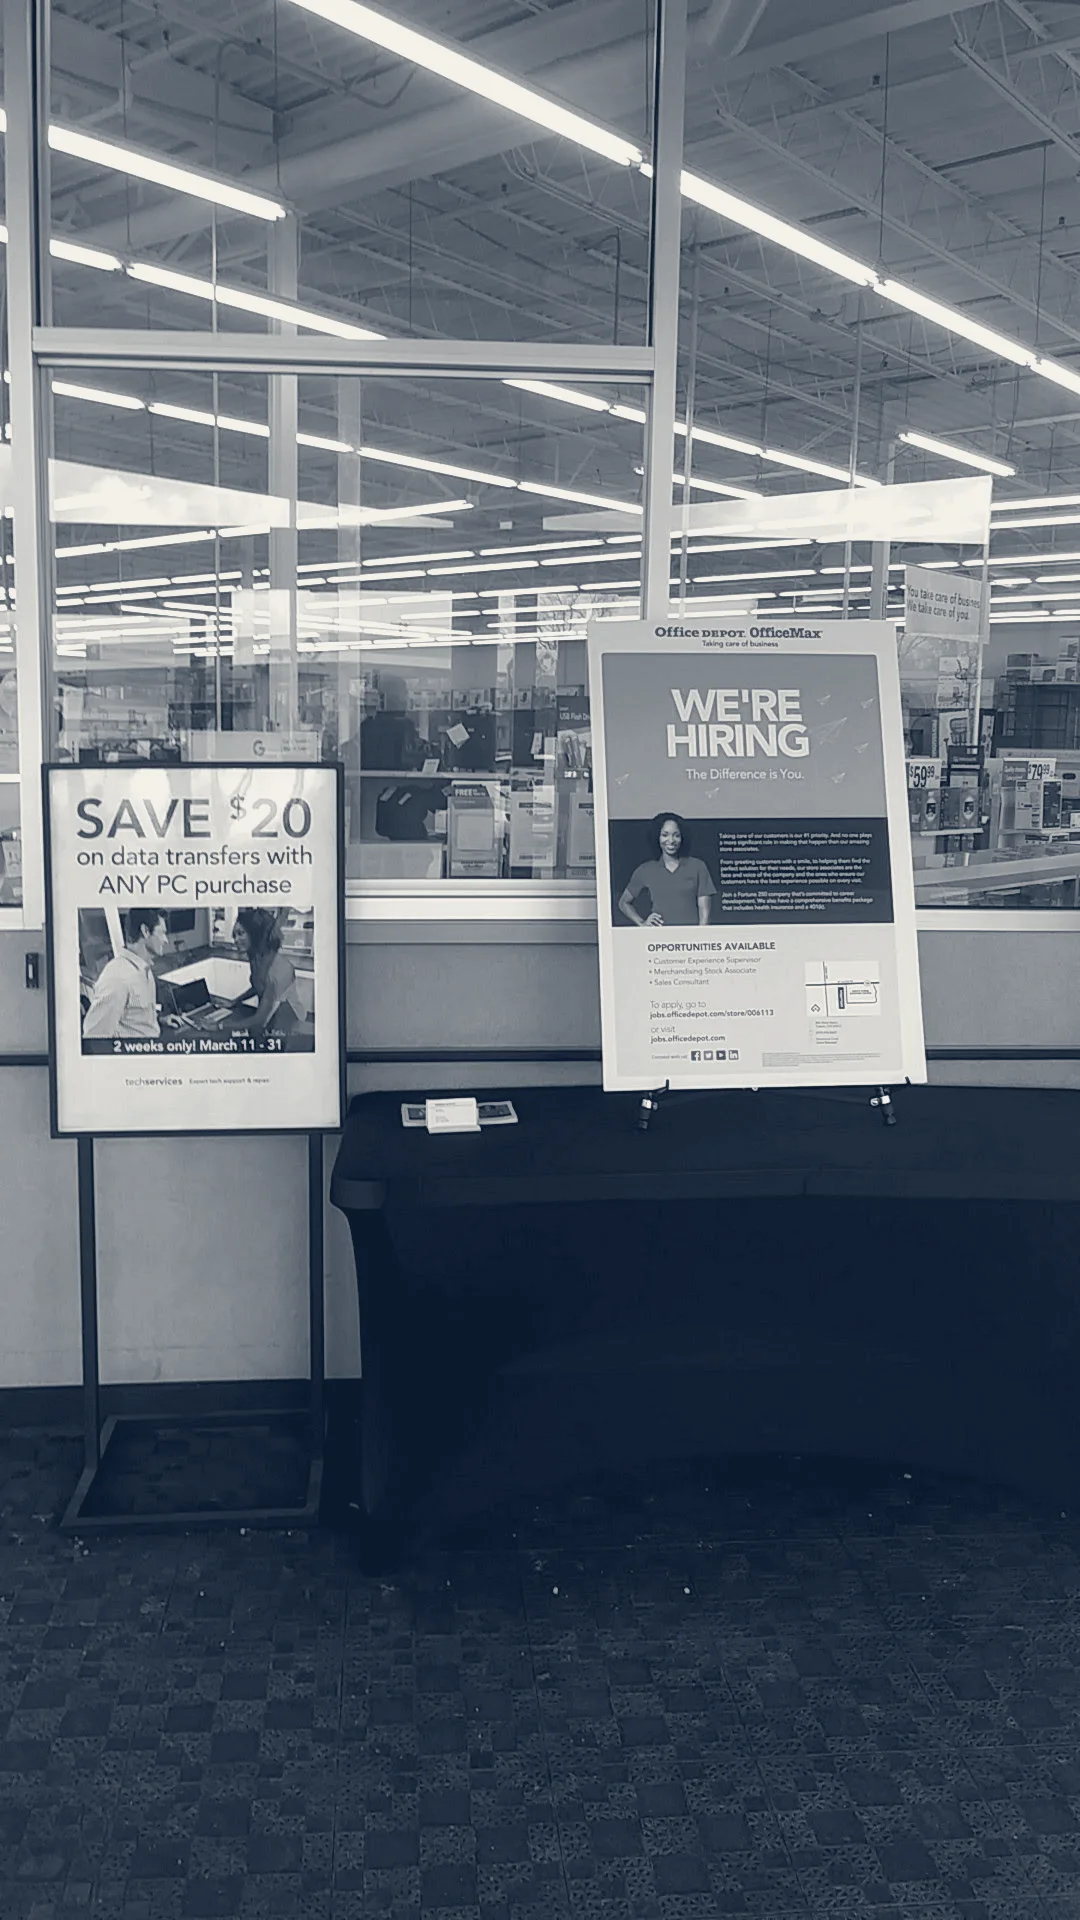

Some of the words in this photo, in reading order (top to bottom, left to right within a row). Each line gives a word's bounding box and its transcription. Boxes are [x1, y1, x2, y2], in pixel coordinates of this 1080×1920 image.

[908, 584, 918, 598] You
[920, 588, 934, 600] take
[935, 592, 948, 603] care
[950, 592, 957, 604] of
[908, 600, 916, 612] We
[918, 602, 932, 614] take
[933, 606, 946, 617] care
[949, 606, 956, 618] of
[655, 626, 699, 638] Office
[750, 627, 822, 639] OfficeMax
[671, 688, 803, 722] WE'RE
[666, 723, 810, 758] HIRING
[686, 768, 707, 780] The
[710, 768, 766, 780] Difference
[769, 769, 778, 780] is
[780, 768, 805, 780] You.
[76, 797, 211, 839] SAVE
[230, 793, 312, 838] $20
[77, 849, 103, 866] on
[111, 846, 159, 866] data
[166, 845, 261, 866] transfers
[267, 845, 313, 865] with
[99, 875, 150, 894] ANY
[157, 875, 187, 894] PC
[195, 874, 292, 900] purchase
[648, 943, 722, 952] OPPORTUNITIES
[725, 942, 776, 951] AVAILABLE
[688, 956, 724, 965] Experience
[726, 956, 762, 964] Supervisor
[661, 1000, 684, 1010] apply,
[649, 1009, 774, 1019] jobs.officedepot.com/store/006113
[650, 1034, 725, 1044] jobs.officedepot.com
[113, 1041, 121, 1052] 2
[126, 1040, 163, 1052] weeks
[167, 1039, 196, 1054] only!
[200, 1039, 237, 1051] March
[241, 1039, 255, 1050] 11
[267, 1039, 282, 1050] 31
[125, 1077, 183, 1086] techservices
